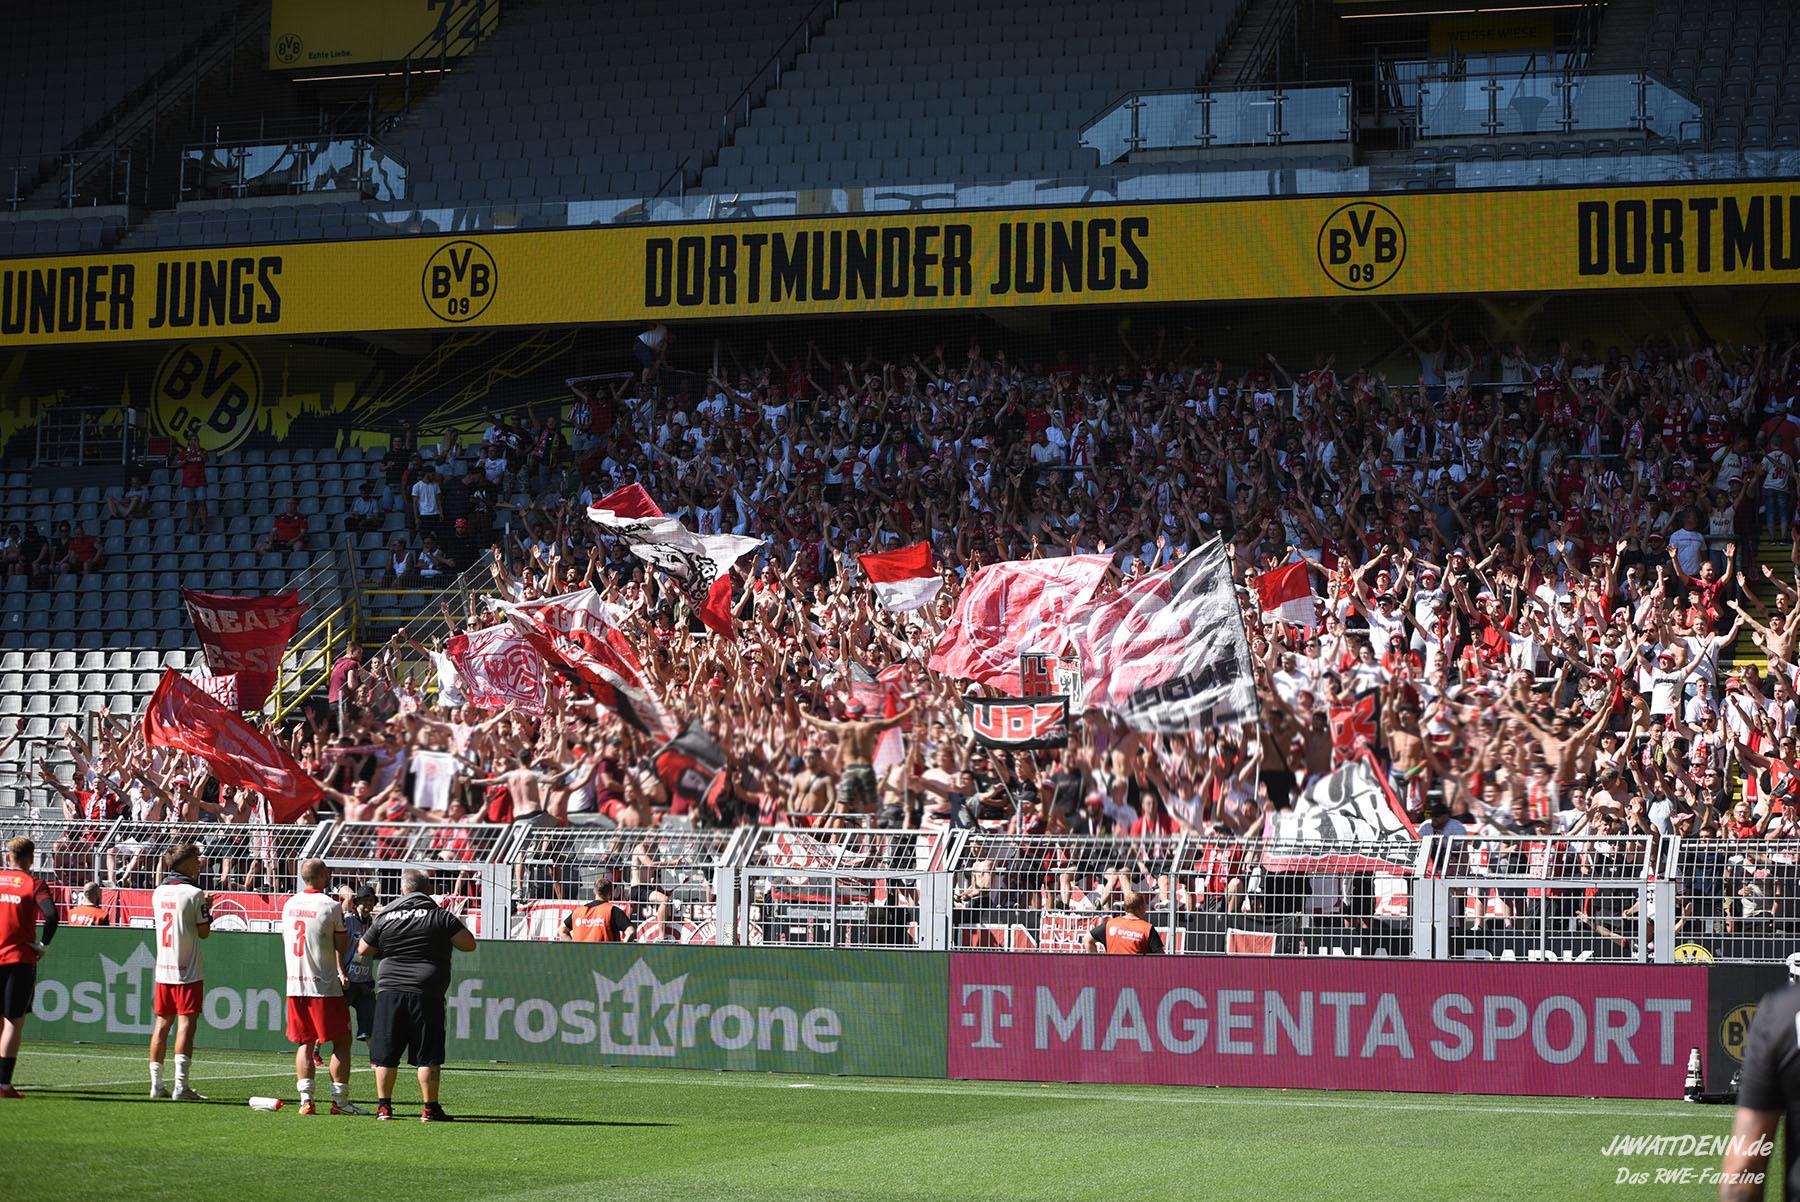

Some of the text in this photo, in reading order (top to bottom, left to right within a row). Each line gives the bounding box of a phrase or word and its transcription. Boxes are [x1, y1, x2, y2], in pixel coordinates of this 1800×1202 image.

[279, 36, 300, 55] BVB
[645, 216, 1149, 307] DORTMUNDER JUNGS
[1329, 210, 1397, 265] BVB
[1, 256, 282, 335] UNDER JUNGS
[431, 247, 490, 298] BVB
[1349, 264, 1375, 283] 09
[447, 296, 470, 315] 09
[163, 349, 248, 434] BVB
[162, 912, 174, 948] 2
[293, 920, 306, 957] 3
[348, 963, 371, 975] FOTO
[446, 978, 843, 1056] frostkrone
[1035, 985, 1417, 1060] MAGENTA
[1430, 993, 1692, 1065] SPORT
